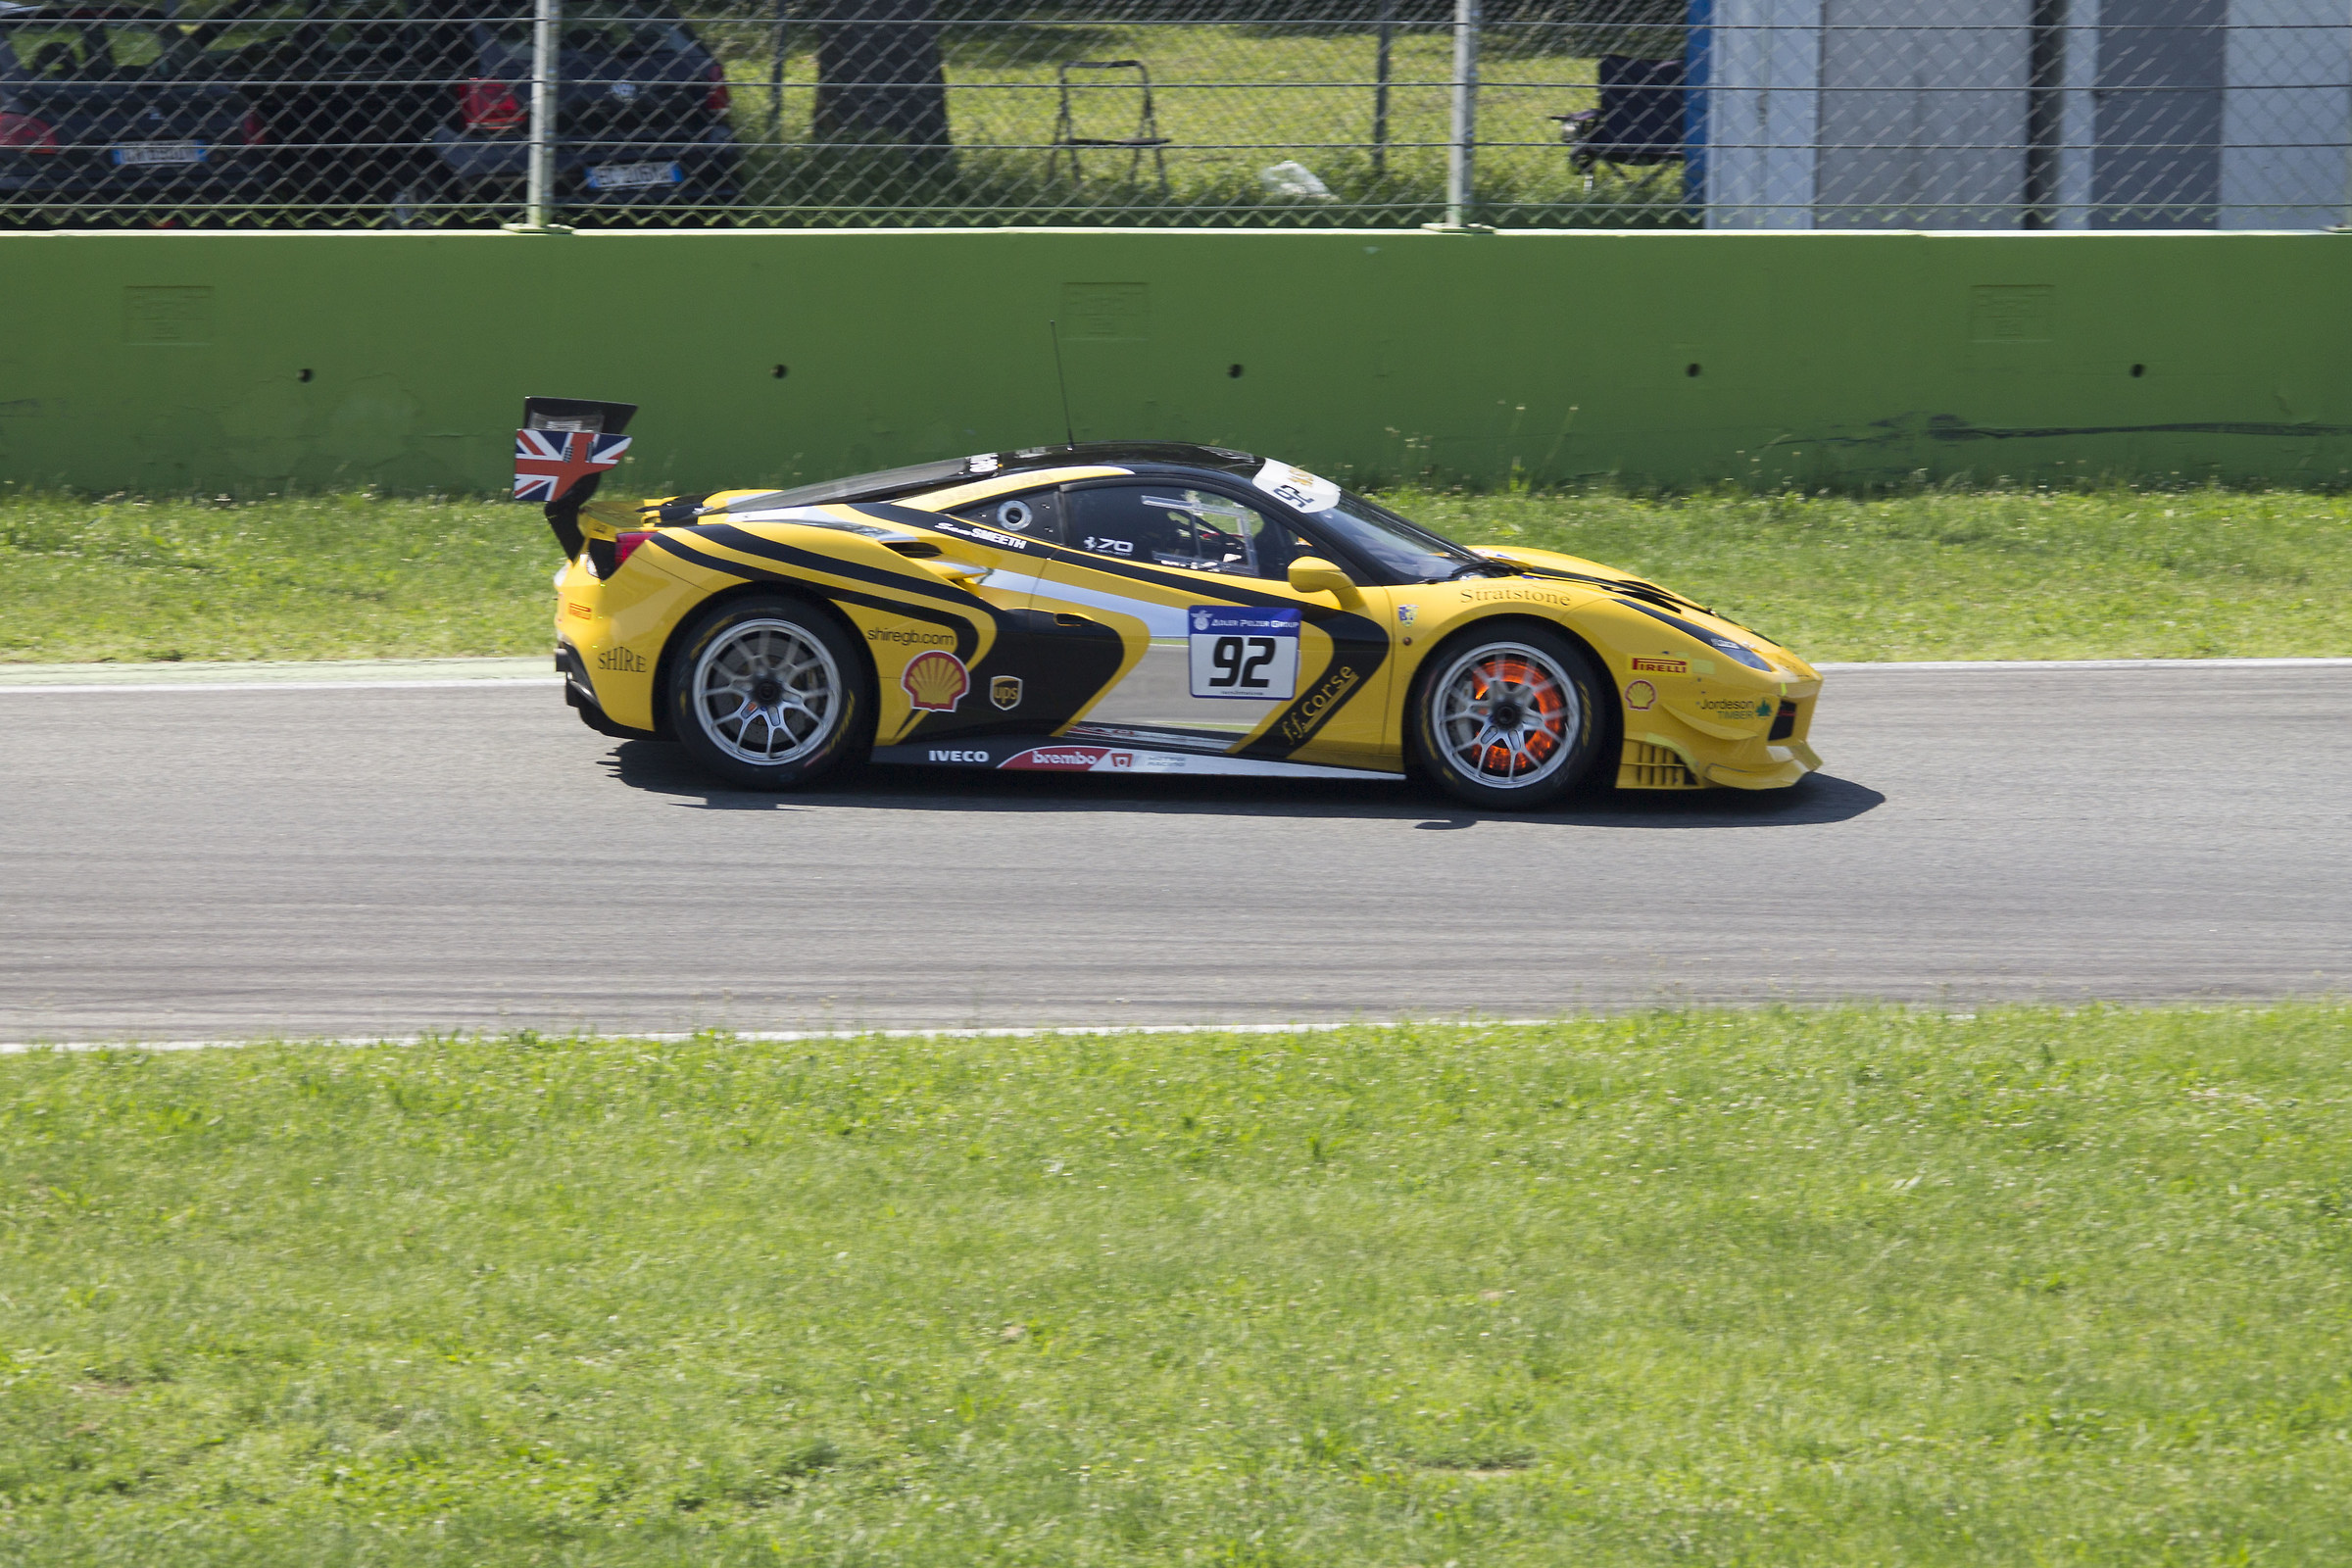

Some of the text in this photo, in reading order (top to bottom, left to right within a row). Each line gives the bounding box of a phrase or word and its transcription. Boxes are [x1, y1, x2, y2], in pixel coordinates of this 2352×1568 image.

[1273, 484, 1314, 508] 92
[1097, 537, 1134, 553] 70
[1460, 588, 1571, 607] Stratstone
[867, 627, 955, 646] shiregb.com
[597, 646, 648, 673] SHIRE
[1208, 636, 1276, 688] 92
[1632, 658, 1688, 674] PIRELLI
[993, 687, 1019, 704] ups
[1700, 698, 1755, 710] Jordeson
[928, 750, 990, 762] IVECO
[1032, 750, 1098, 765] brembo
